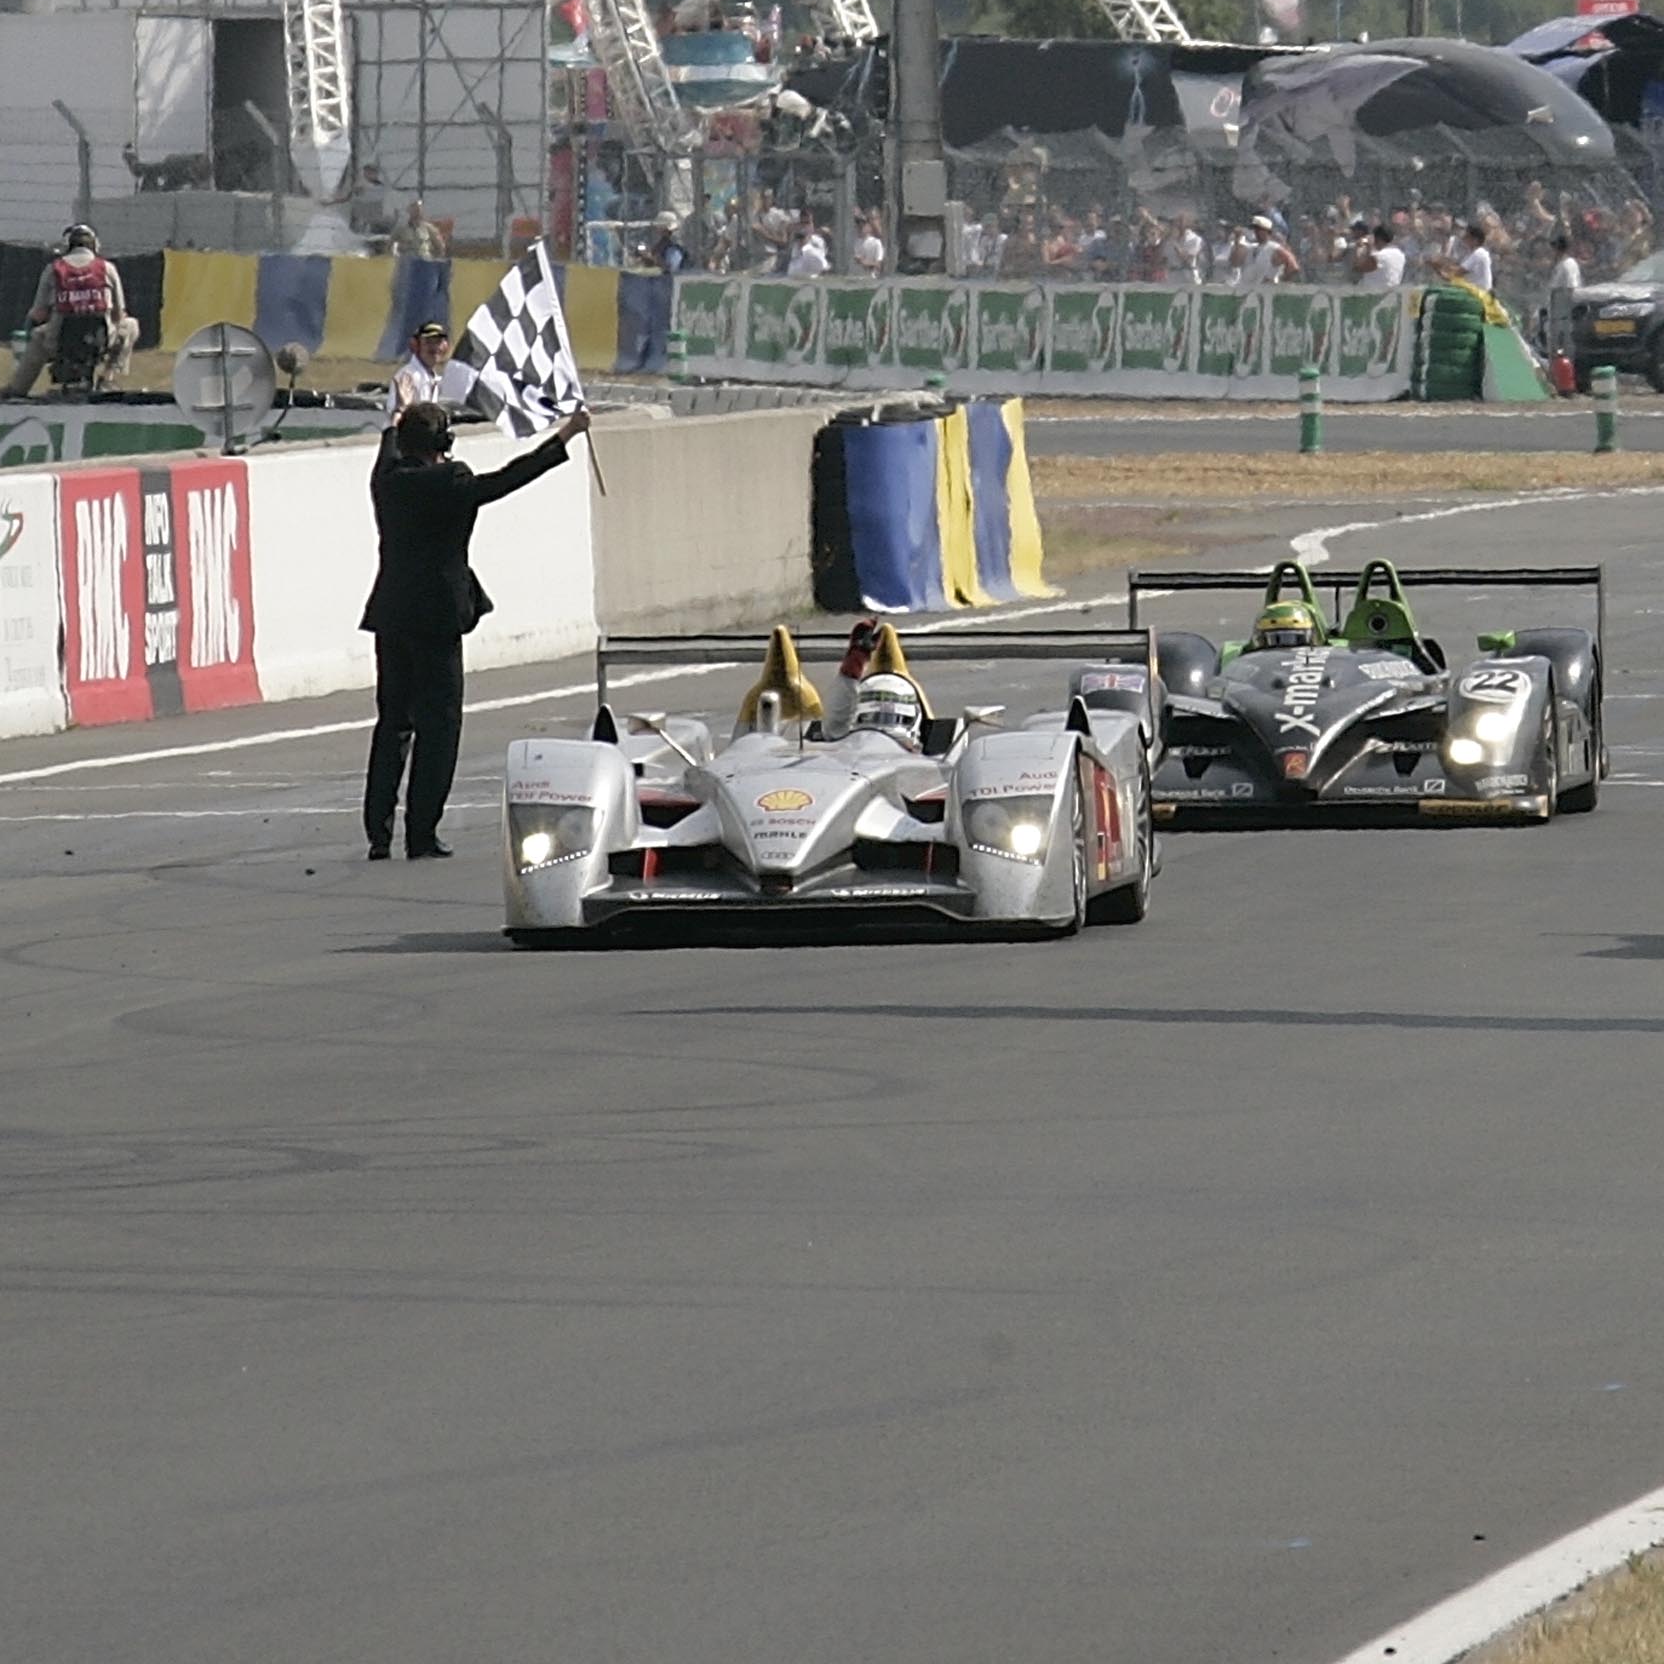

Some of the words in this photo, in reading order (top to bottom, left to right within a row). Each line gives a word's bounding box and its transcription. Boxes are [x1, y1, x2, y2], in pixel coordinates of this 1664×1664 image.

[188, 482, 239, 668] RMC
[75, 491, 129, 682] RMC
[1473, 672, 1519, 693] 22
[1019, 771, 1058, 781] Audi
[767, 818, 817, 826] BOSCH
